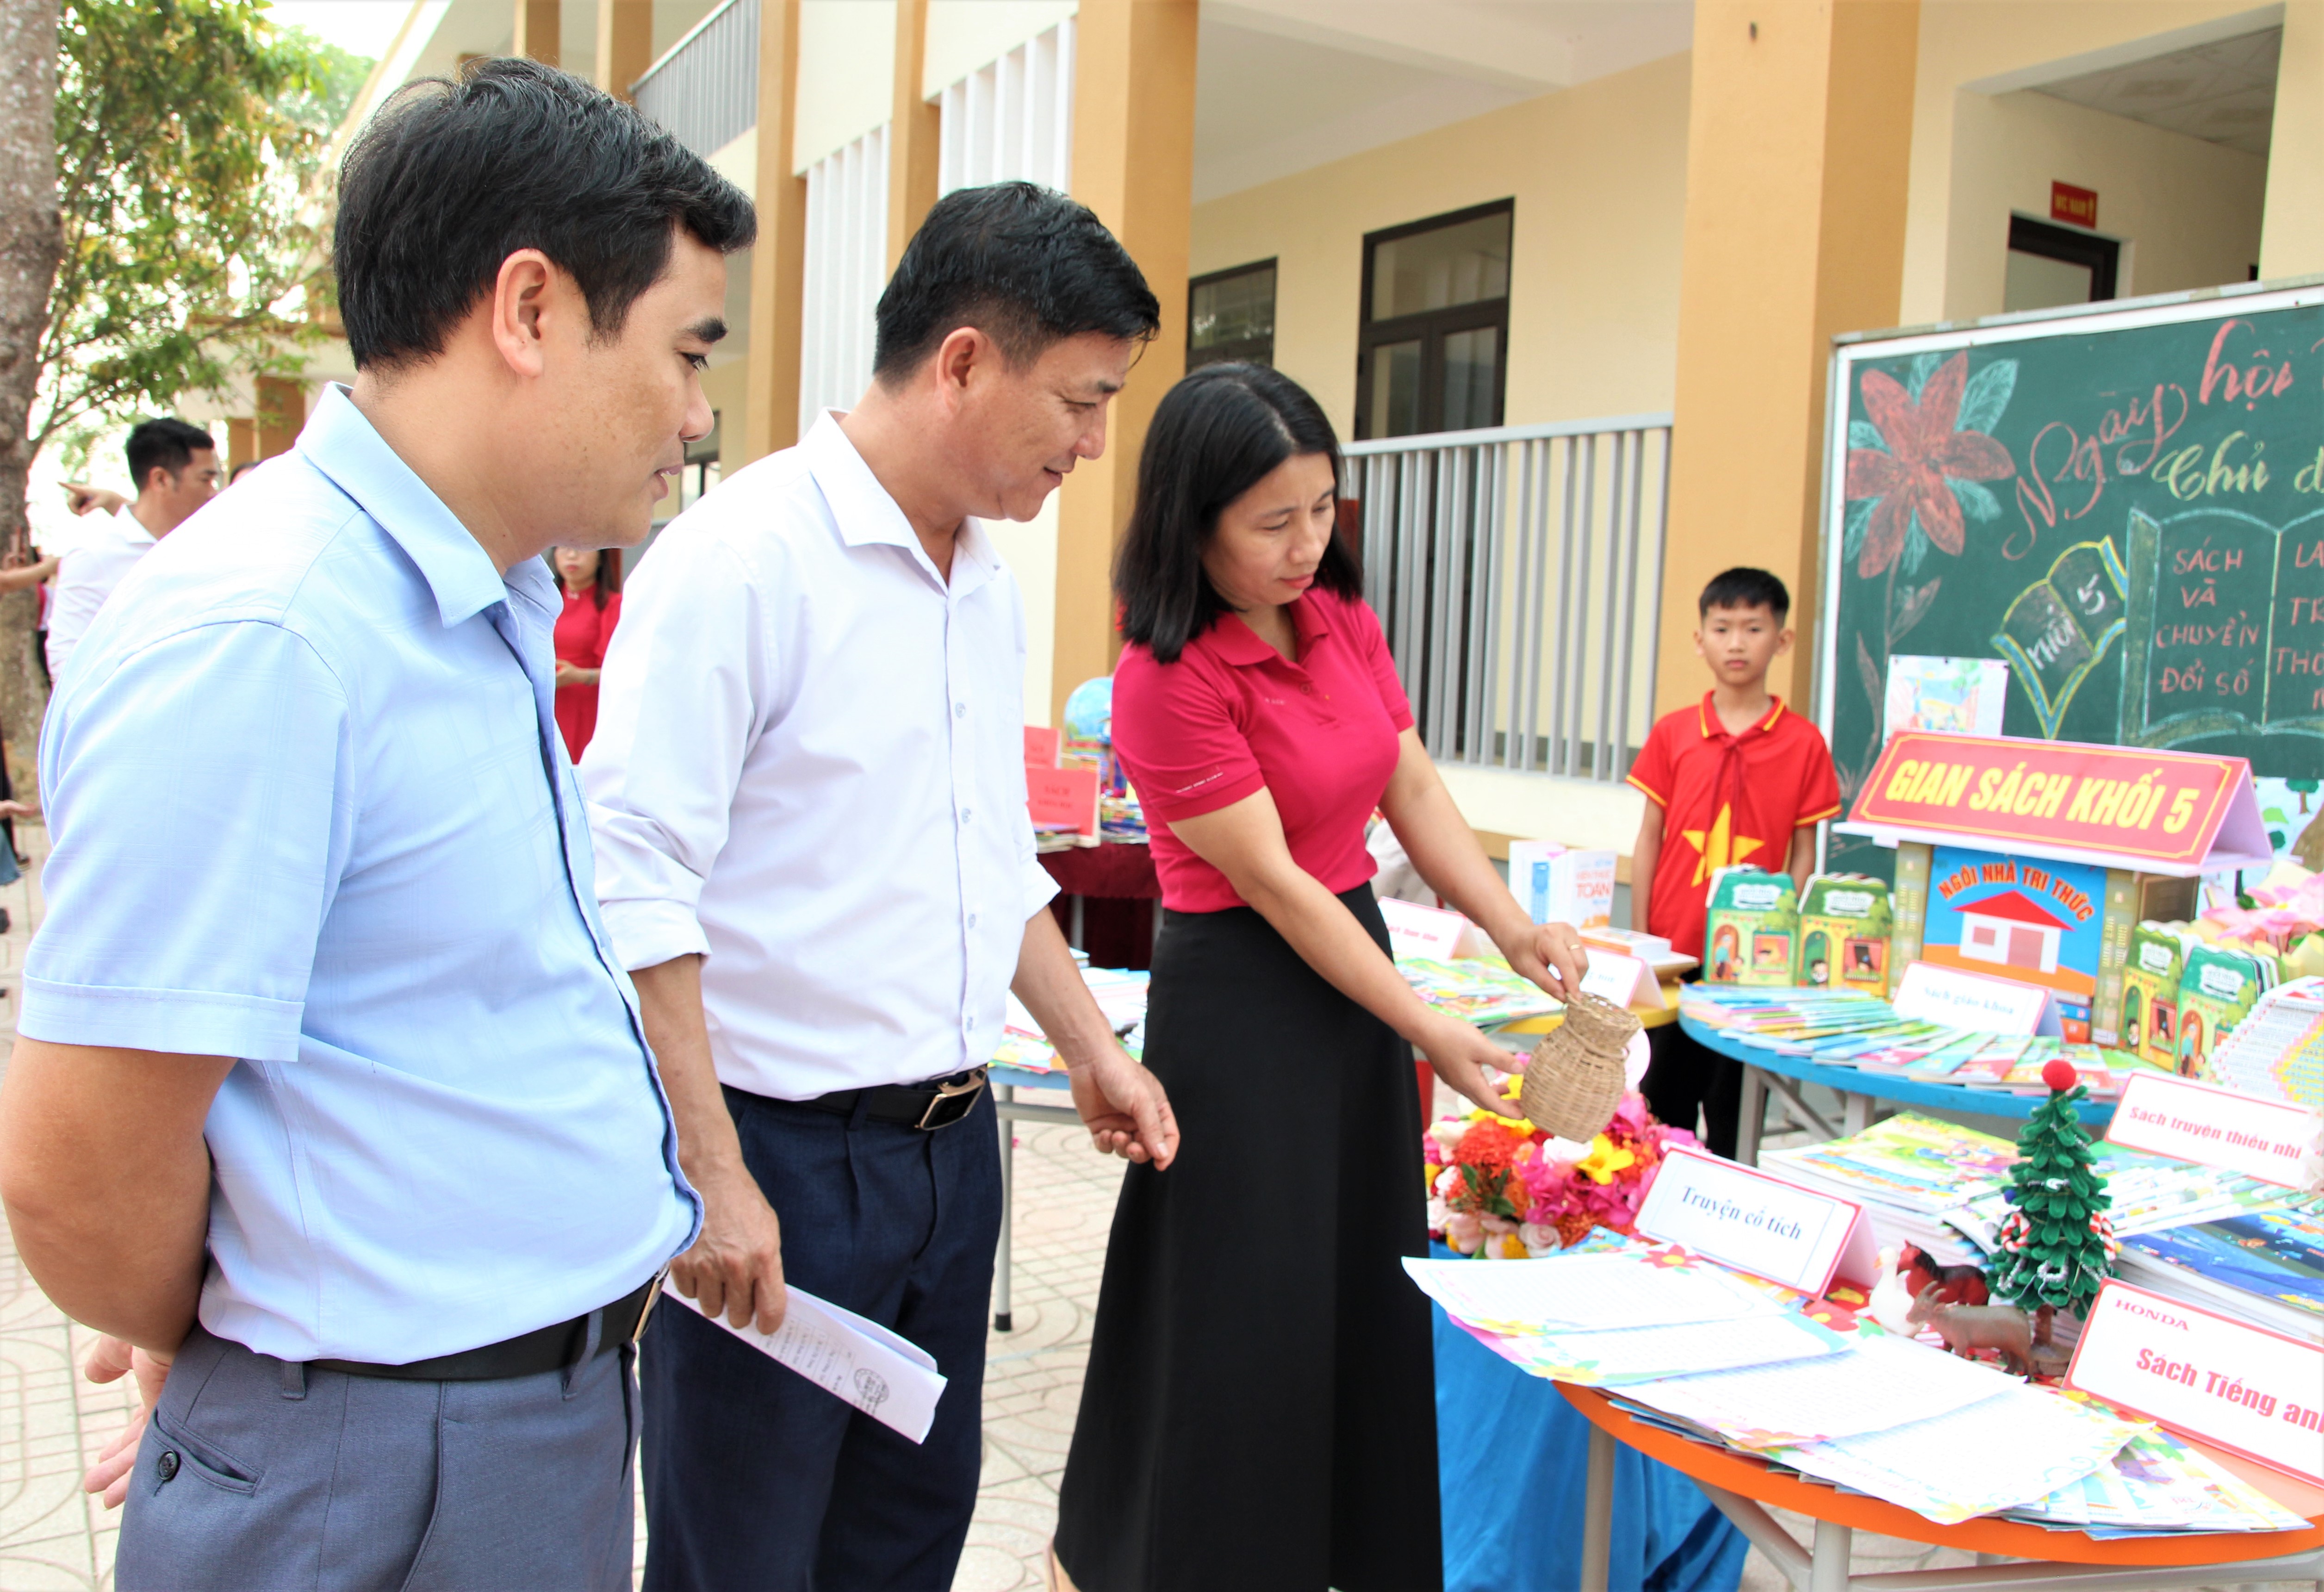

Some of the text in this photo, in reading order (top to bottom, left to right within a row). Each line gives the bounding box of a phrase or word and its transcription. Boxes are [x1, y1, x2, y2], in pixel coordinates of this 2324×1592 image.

[2199, 318, 2294, 411] hội
[2151, 430, 2270, 501] Chủ
[2173, 535, 2243, 574] SÁCH
[2076, 573, 2106, 616] 5
[2156, 610, 2260, 648] CHUYỂN
[2158, 658, 2254, 696] ĐỔI SỐ
[1885, 759, 2201, 834] GIAN SÁCH KHỐI 5
[1937, 858, 2095, 922] NGÔI NHÀ TRI THỨC
[2170, 1117, 2223, 1140] truyện
[2272, 1142, 2303, 1160] nhi
[1682, 1185, 1802, 1240] Truyện cổ tích
[2115, 1299, 2190, 1332] HONDA
[2136, 1348, 2198, 1387] Sách
[2205, 1370, 2278, 1418] Tiếng
